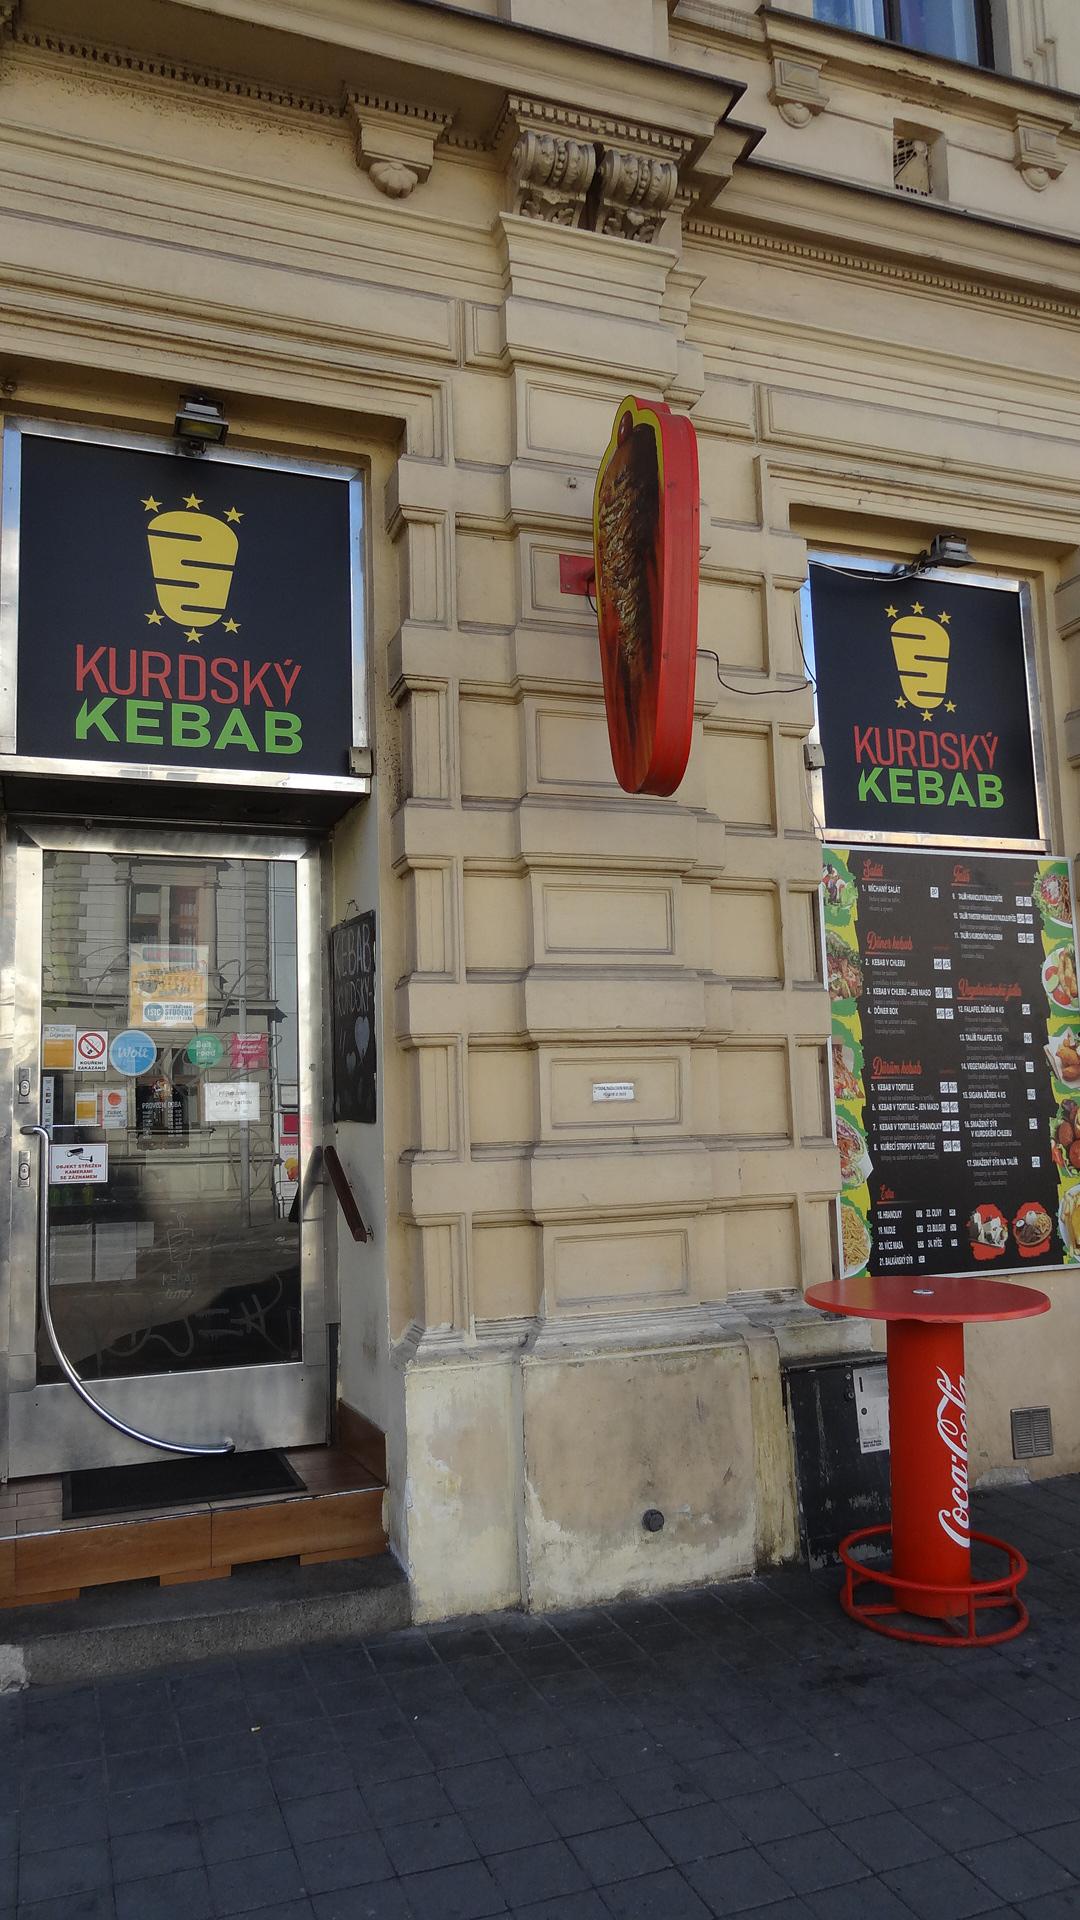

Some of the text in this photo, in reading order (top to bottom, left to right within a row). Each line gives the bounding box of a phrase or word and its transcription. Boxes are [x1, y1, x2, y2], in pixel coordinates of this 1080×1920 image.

[75, 643, 302, 708] KURDSKÝ
[75, 697, 303, 755] KEBAB
[853, 725, 999, 771] KURDSKÝ
[858, 767, 1005, 808] KEBAB
[888, 884, 901, 894] SALÁT
[334, 923, 371, 980] KEBAB
[872, 958, 885, 966] KEBAB
[890, 959, 906, 967] CHLEBU
[873, 988, 887, 996] KEBAB
[891, 988, 907, 996] CHLEBU
[919, 989, 932, 997] MASO
[165, 1008, 193, 1016] STUDENT
[874, 1006, 889, 1015] DÖNER
[889, 1007, 899, 1015] BOX
[118, 1046, 149, 1058] Wolt
[196, 1049, 216, 1057] Food
[895, 1083, 914, 1091] TORTILLE
[984, 1090, 997, 1099] BÖREK
[878, 1103, 892, 1111] KEBAB
[896, 1103, 915, 1111] TORTILLE
[918, 1103, 927, 1111] JEN
[927, 1103, 939, 1111] MASO
[879, 1123, 893, 1131] KEBAB
[897, 1123, 916, 1131] TORTILLE
[920, 1123, 942, 1131] HRANOLKY
[990, 1119, 998, 1128] SÝR
[897, 1143, 913, 1151] STRIPSY
[917, 1142, 935, 1150] TORTILLE
